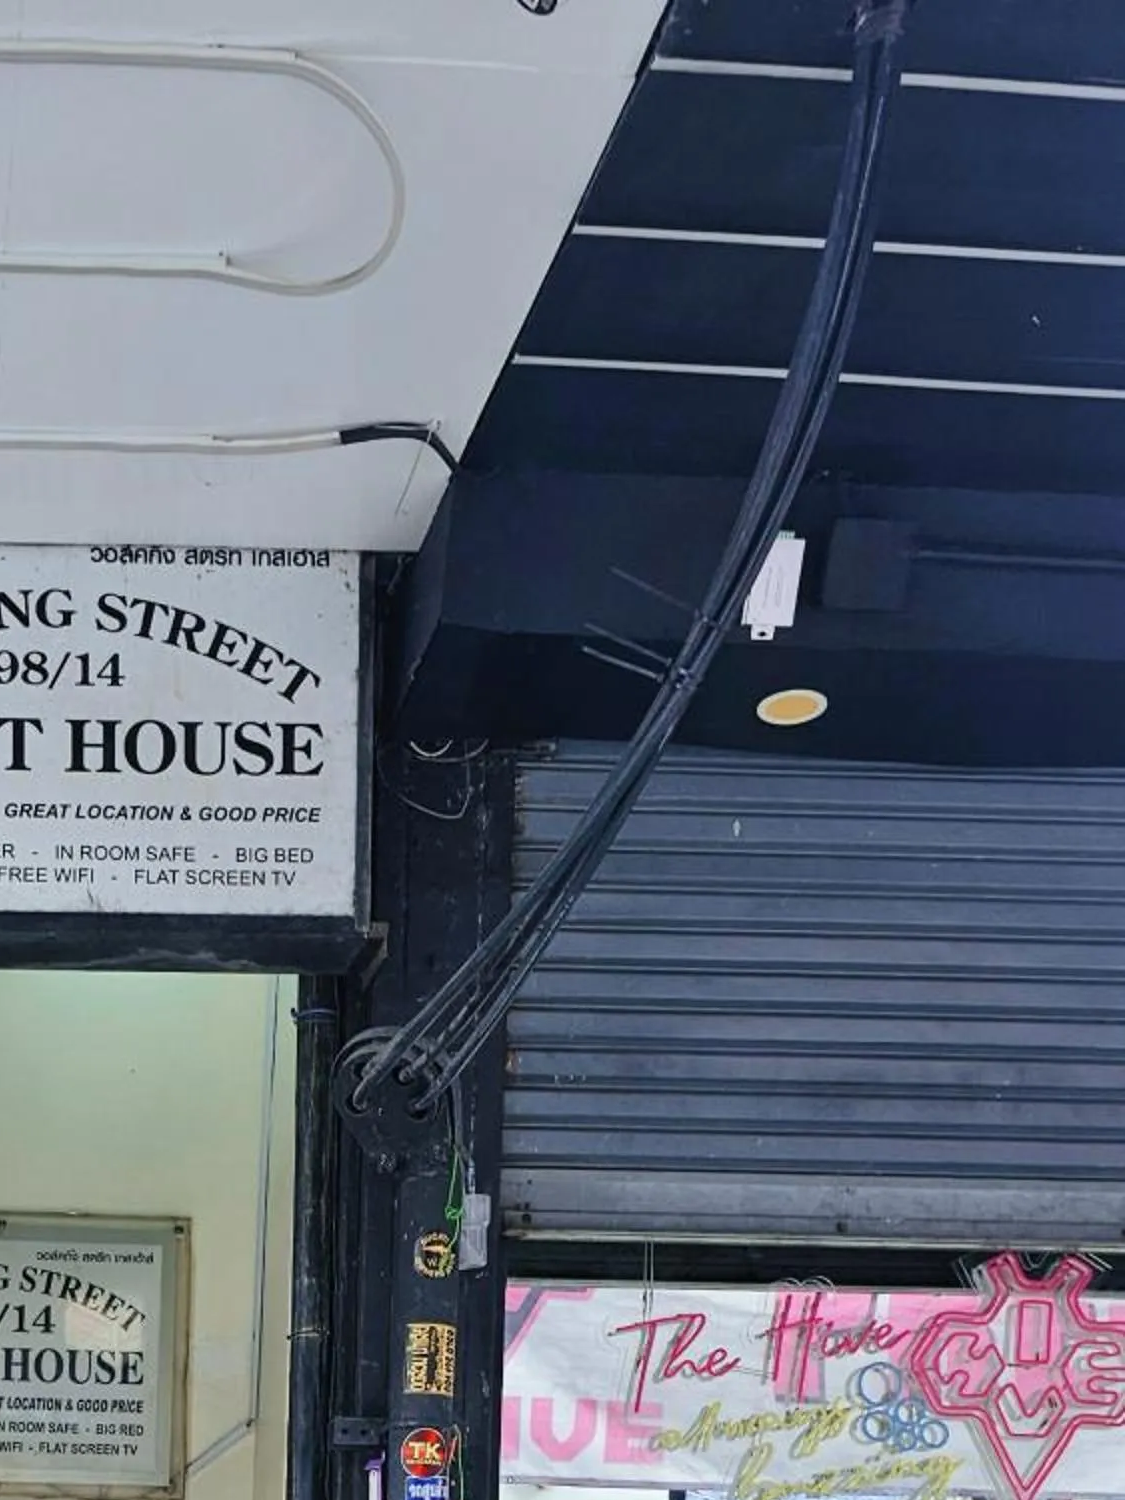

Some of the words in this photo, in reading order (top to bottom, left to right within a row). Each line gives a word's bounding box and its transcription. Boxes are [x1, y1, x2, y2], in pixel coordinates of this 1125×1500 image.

[95, 592, 321, 704] STREET
[64, 719, 324, 777] HOUSE
[4, 803, 71, 819] GREAT
[75, 803, 174, 822] LOCATION
[179, 804, 192, 822] &
[198, 806, 257, 823] GOOD
[262, 807, 322, 824] PRICE
[55, 845, 73, 861] IN
[80, 845, 140, 862] ROOM
[145, 846, 196, 863] SAFE
[236, 847, 268, 864] BIG
[274, 848, 314, 864] BED
[54, 867, 94, 884] WIFI
[134, 868, 179, 885] FLAT
[185, 869, 266, 886] SCREEN
[271, 870, 296, 887] TV
[19, 1265, 146, 1333] STREET
[0, 1346, 145, 1386] HOUSE
[607, 1313, 741, 1414] The
[7, 1396, 63, 1412] LOCATION
[77, 1399, 108, 1413] GOOD
[111, 1400, 144, 1414] PRICE
[8, 1420, 46, 1434] ROOM
[48, 1422, 80, 1435] SAFE
[38, 1441, 68, 1454] FLAT
[70, 1443, 120, 1456] SCREEN
[123, 1443, 139, 1456] TV
[408, 1441, 441, 1459] TK
